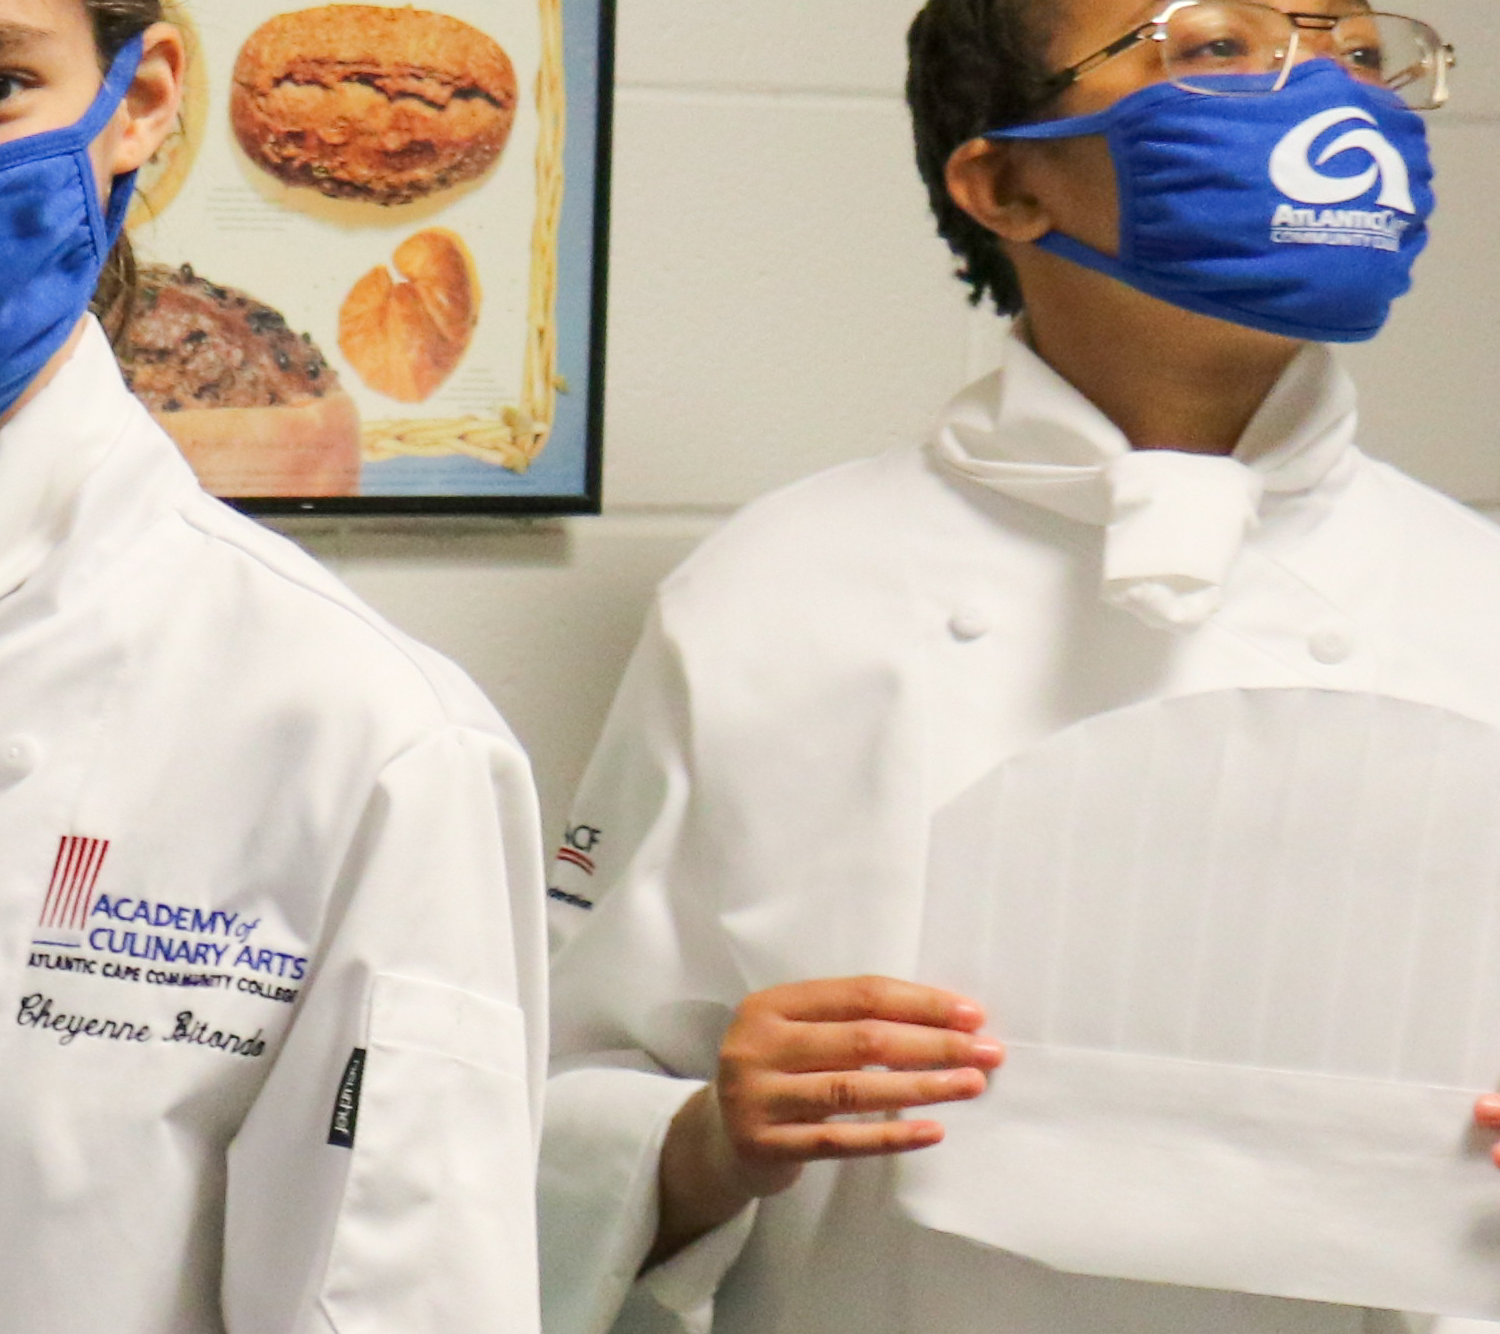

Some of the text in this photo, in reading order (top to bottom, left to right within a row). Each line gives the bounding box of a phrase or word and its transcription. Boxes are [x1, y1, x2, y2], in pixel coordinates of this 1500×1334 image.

[91, 894, 261, 944] ACADEMY of
[28, 952, 97, 975] ATLANTIC
[102, 962, 140, 982] CAPE
[146, 970, 233, 989] COMMUNITY
[89, 928, 309, 981] CULINARY ARTS
[17, 993, 151, 1045] Cheyenne
